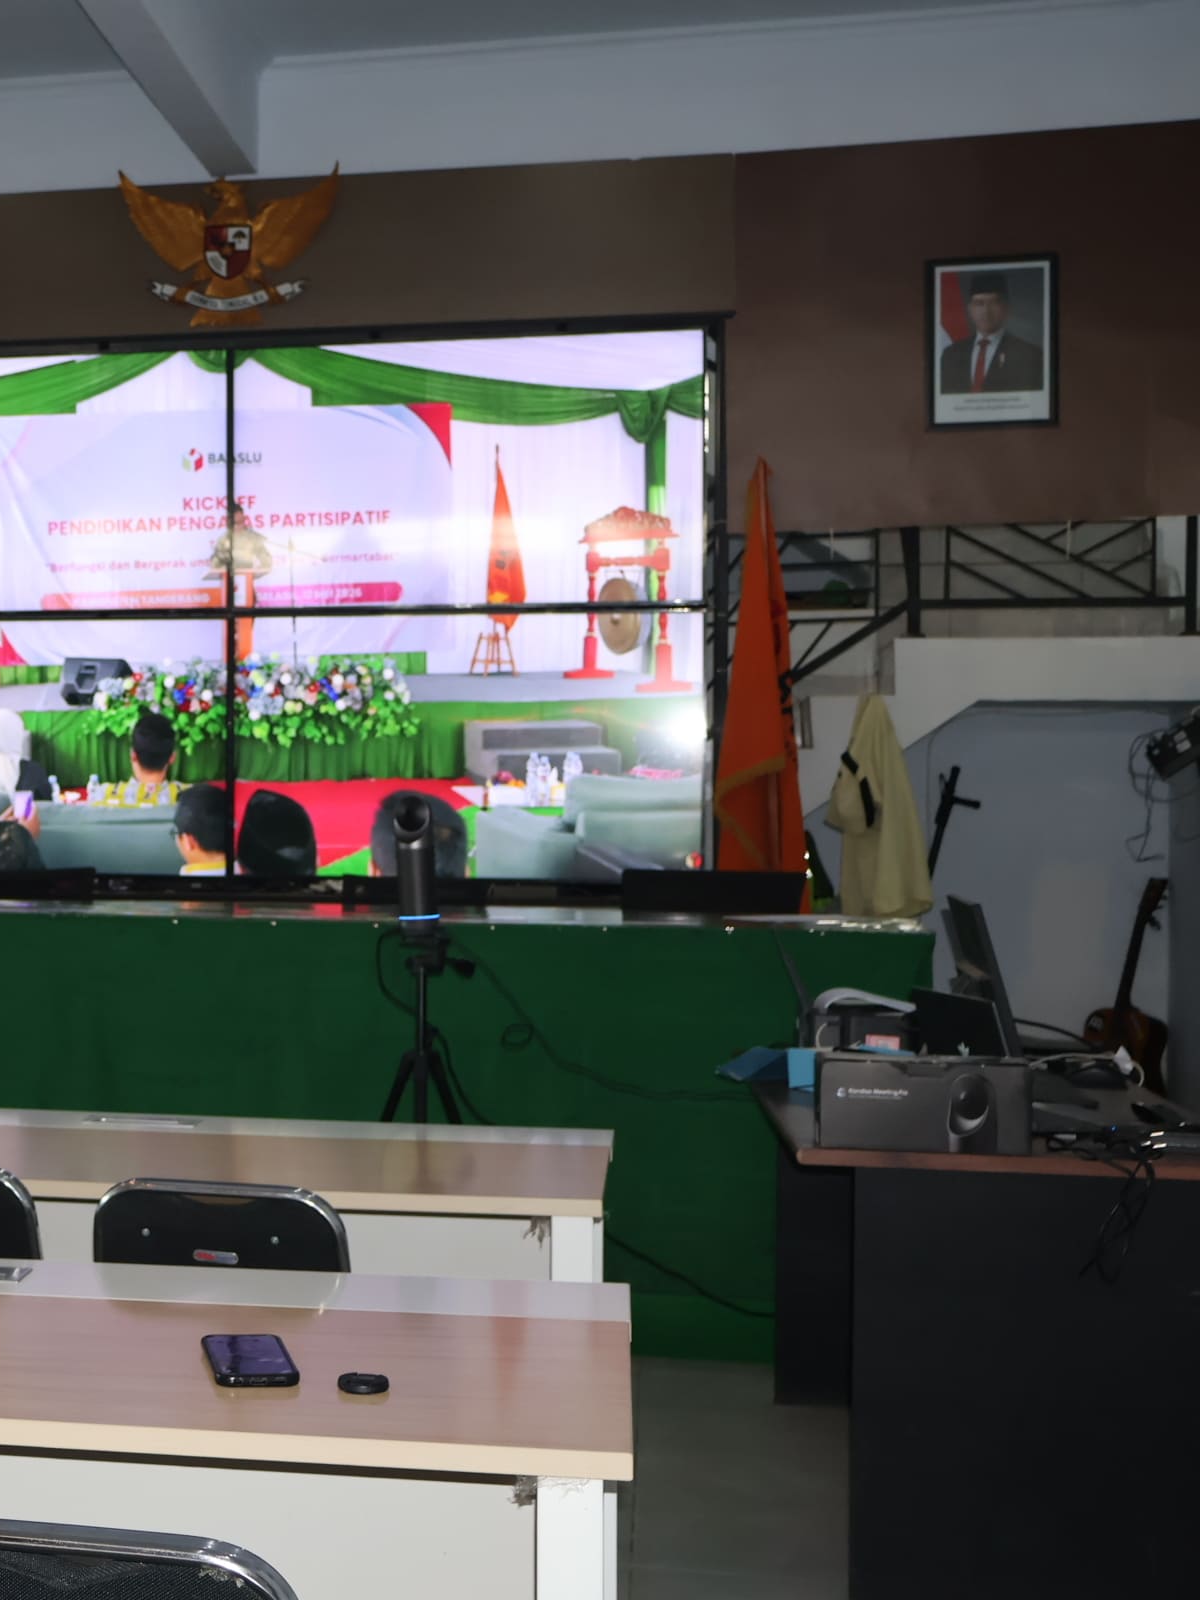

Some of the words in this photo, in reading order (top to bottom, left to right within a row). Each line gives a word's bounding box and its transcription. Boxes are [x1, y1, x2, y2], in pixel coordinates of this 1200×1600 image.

[208, 452, 263, 464] BASLU
[183, 495, 256, 511] KICKFF
[48, 519, 161, 535] PENDIDIKAN
[168, 515, 264, 531] PENGAAS
[270, 510, 390, 528] PARTISIPATIF
